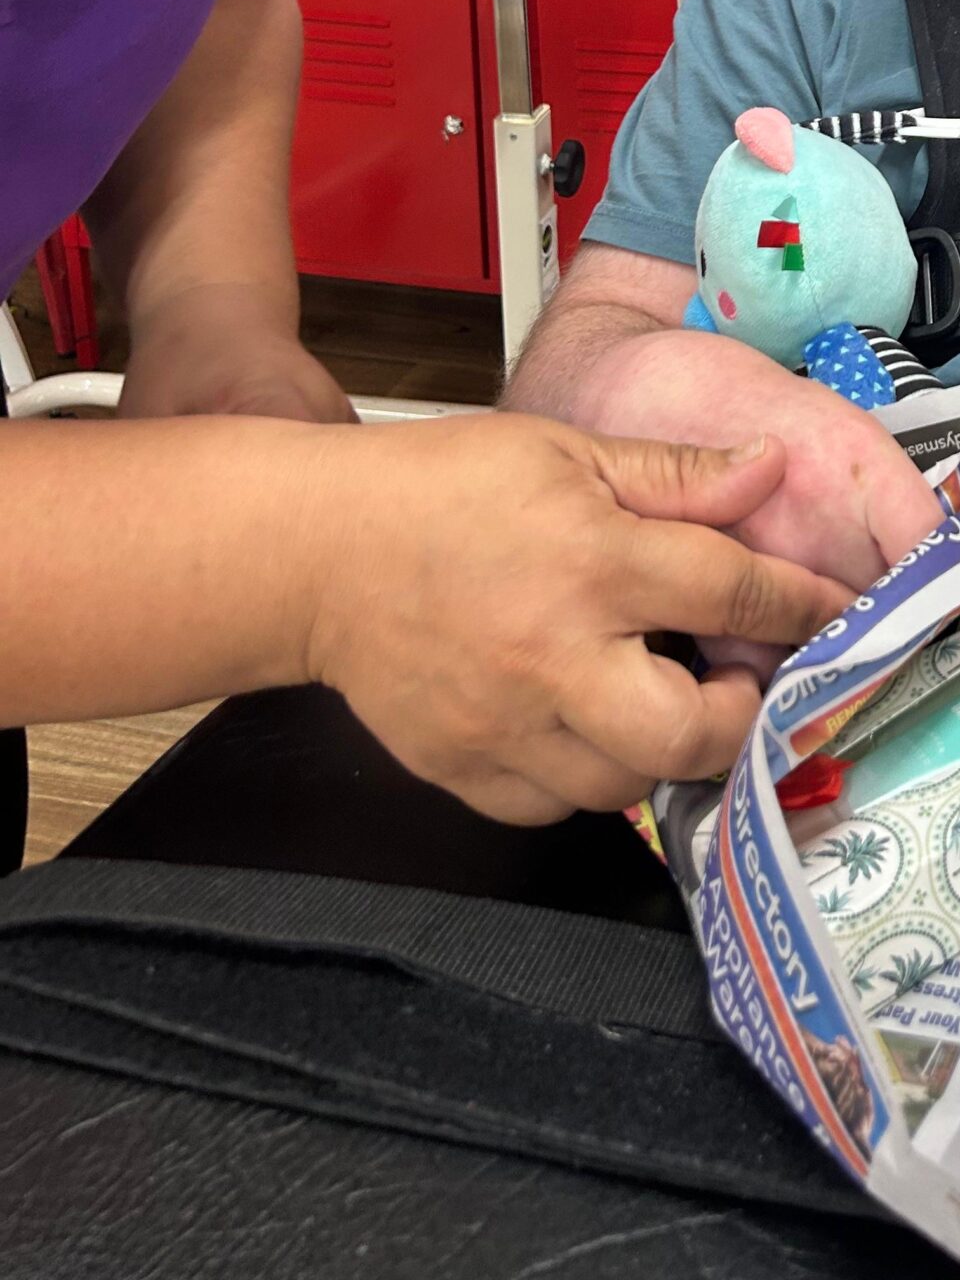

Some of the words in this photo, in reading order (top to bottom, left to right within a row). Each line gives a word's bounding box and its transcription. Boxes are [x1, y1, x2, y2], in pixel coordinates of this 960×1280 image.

[707, 876, 805, 1114] Appliance
[733, 767, 819, 1012] Directory
[919, 1010, 960, 1034] Your
